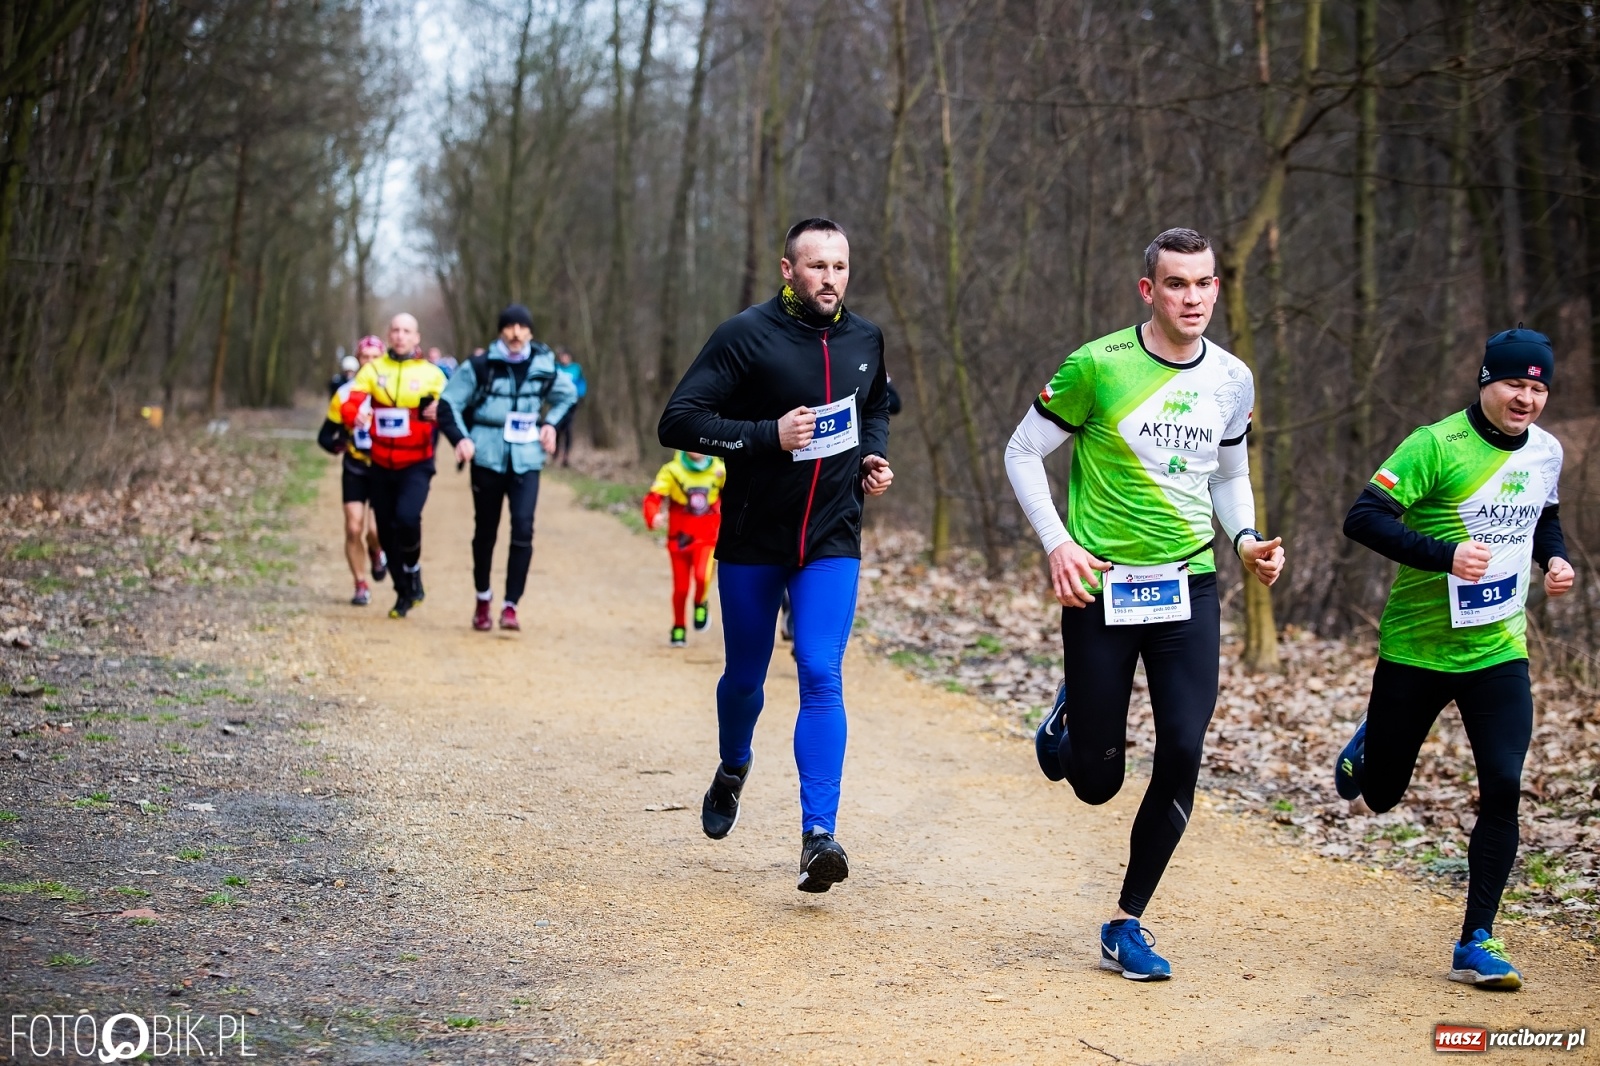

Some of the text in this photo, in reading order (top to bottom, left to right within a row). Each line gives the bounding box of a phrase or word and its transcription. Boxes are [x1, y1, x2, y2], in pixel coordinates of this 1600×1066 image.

[819, 418, 836, 434] 92
[1139, 422, 1213, 443] AKTYWNI
[1156, 438, 1199, 451] LYSKI
[1131, 586, 1161, 602] 185
[1482, 586, 1502, 603] 91
